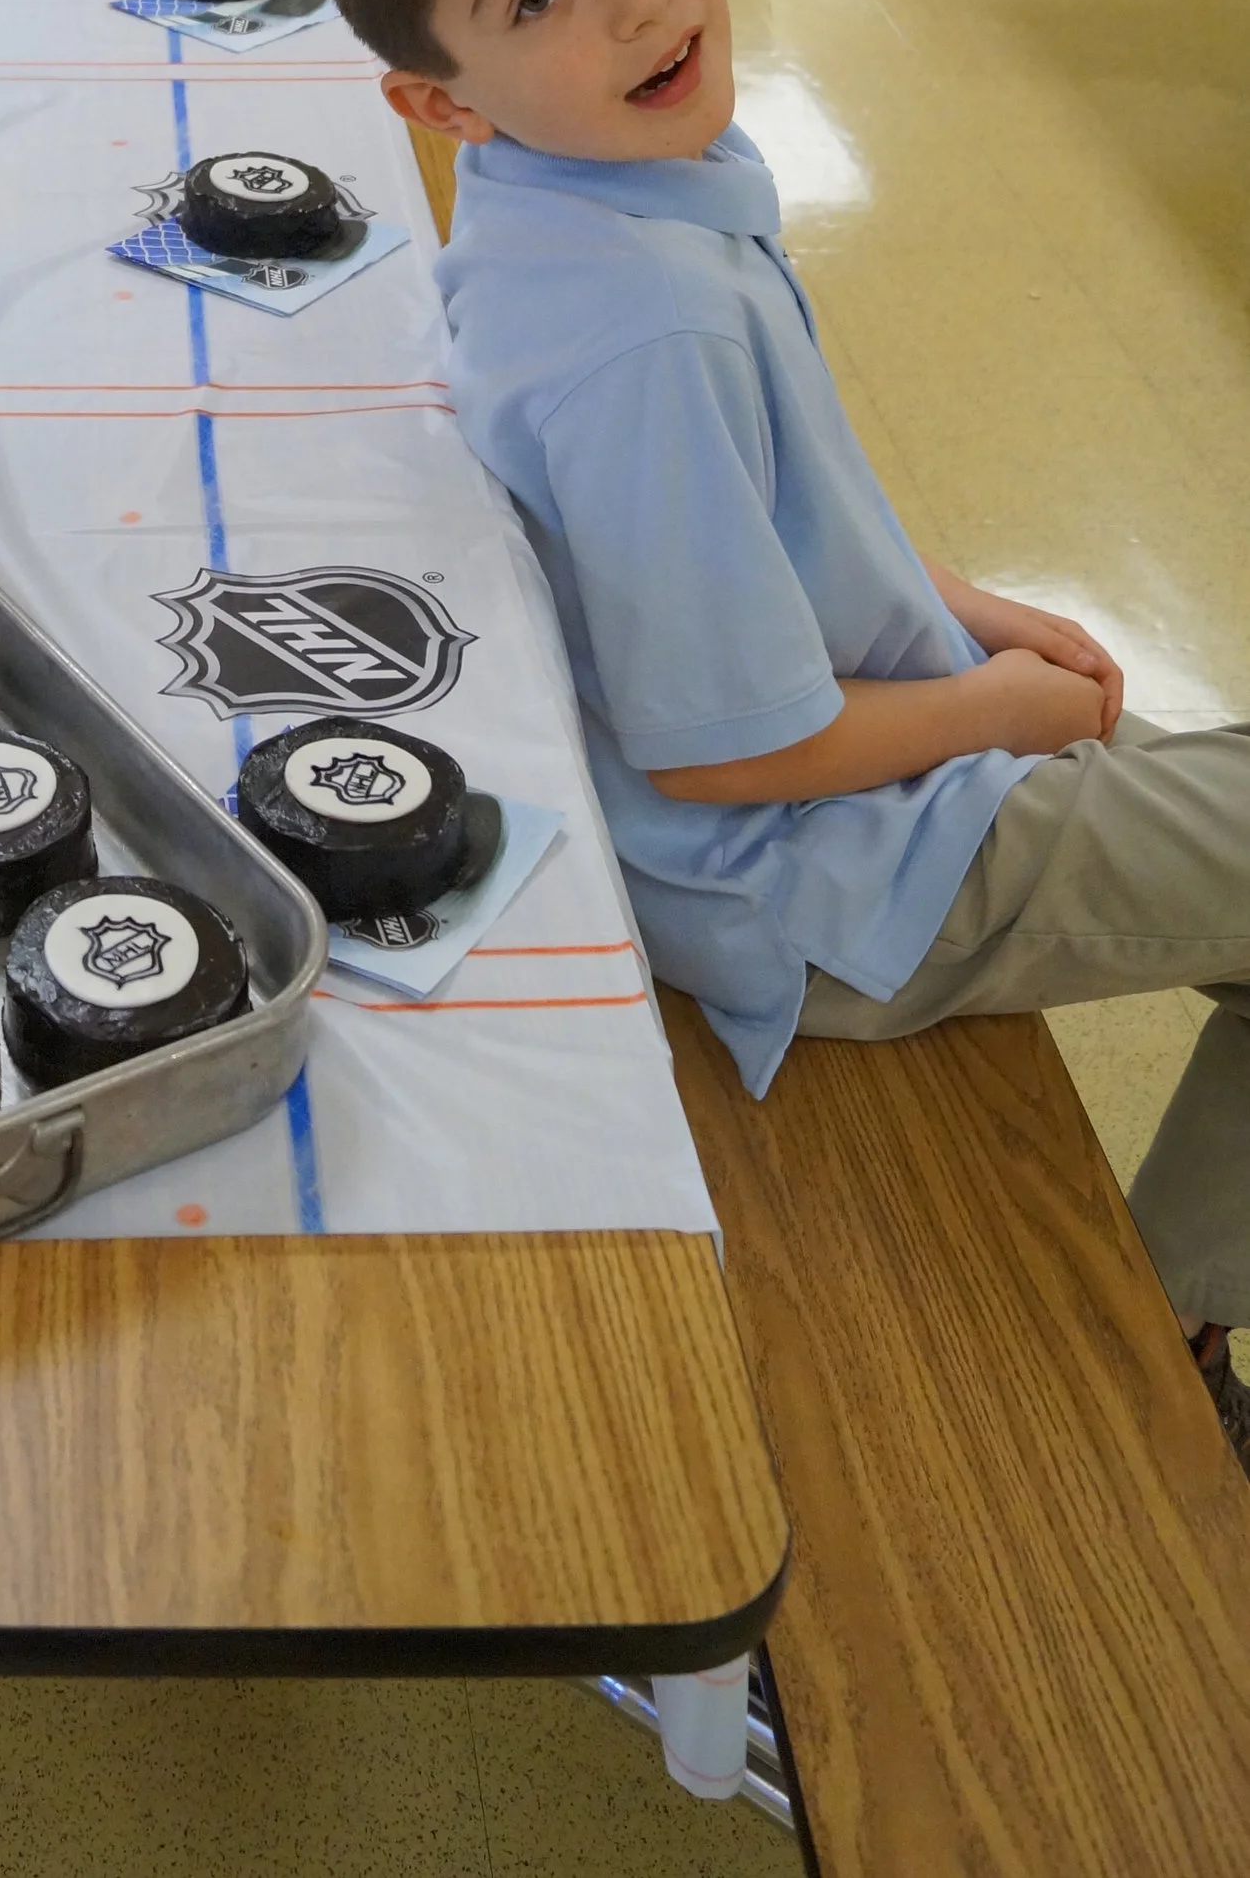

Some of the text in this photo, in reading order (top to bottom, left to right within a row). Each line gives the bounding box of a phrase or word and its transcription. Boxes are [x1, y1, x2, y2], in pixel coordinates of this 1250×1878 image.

[269, 269, 283, 287] NHL
[238, 598, 408, 683] NHL
[102, 941, 150, 965] NHL
